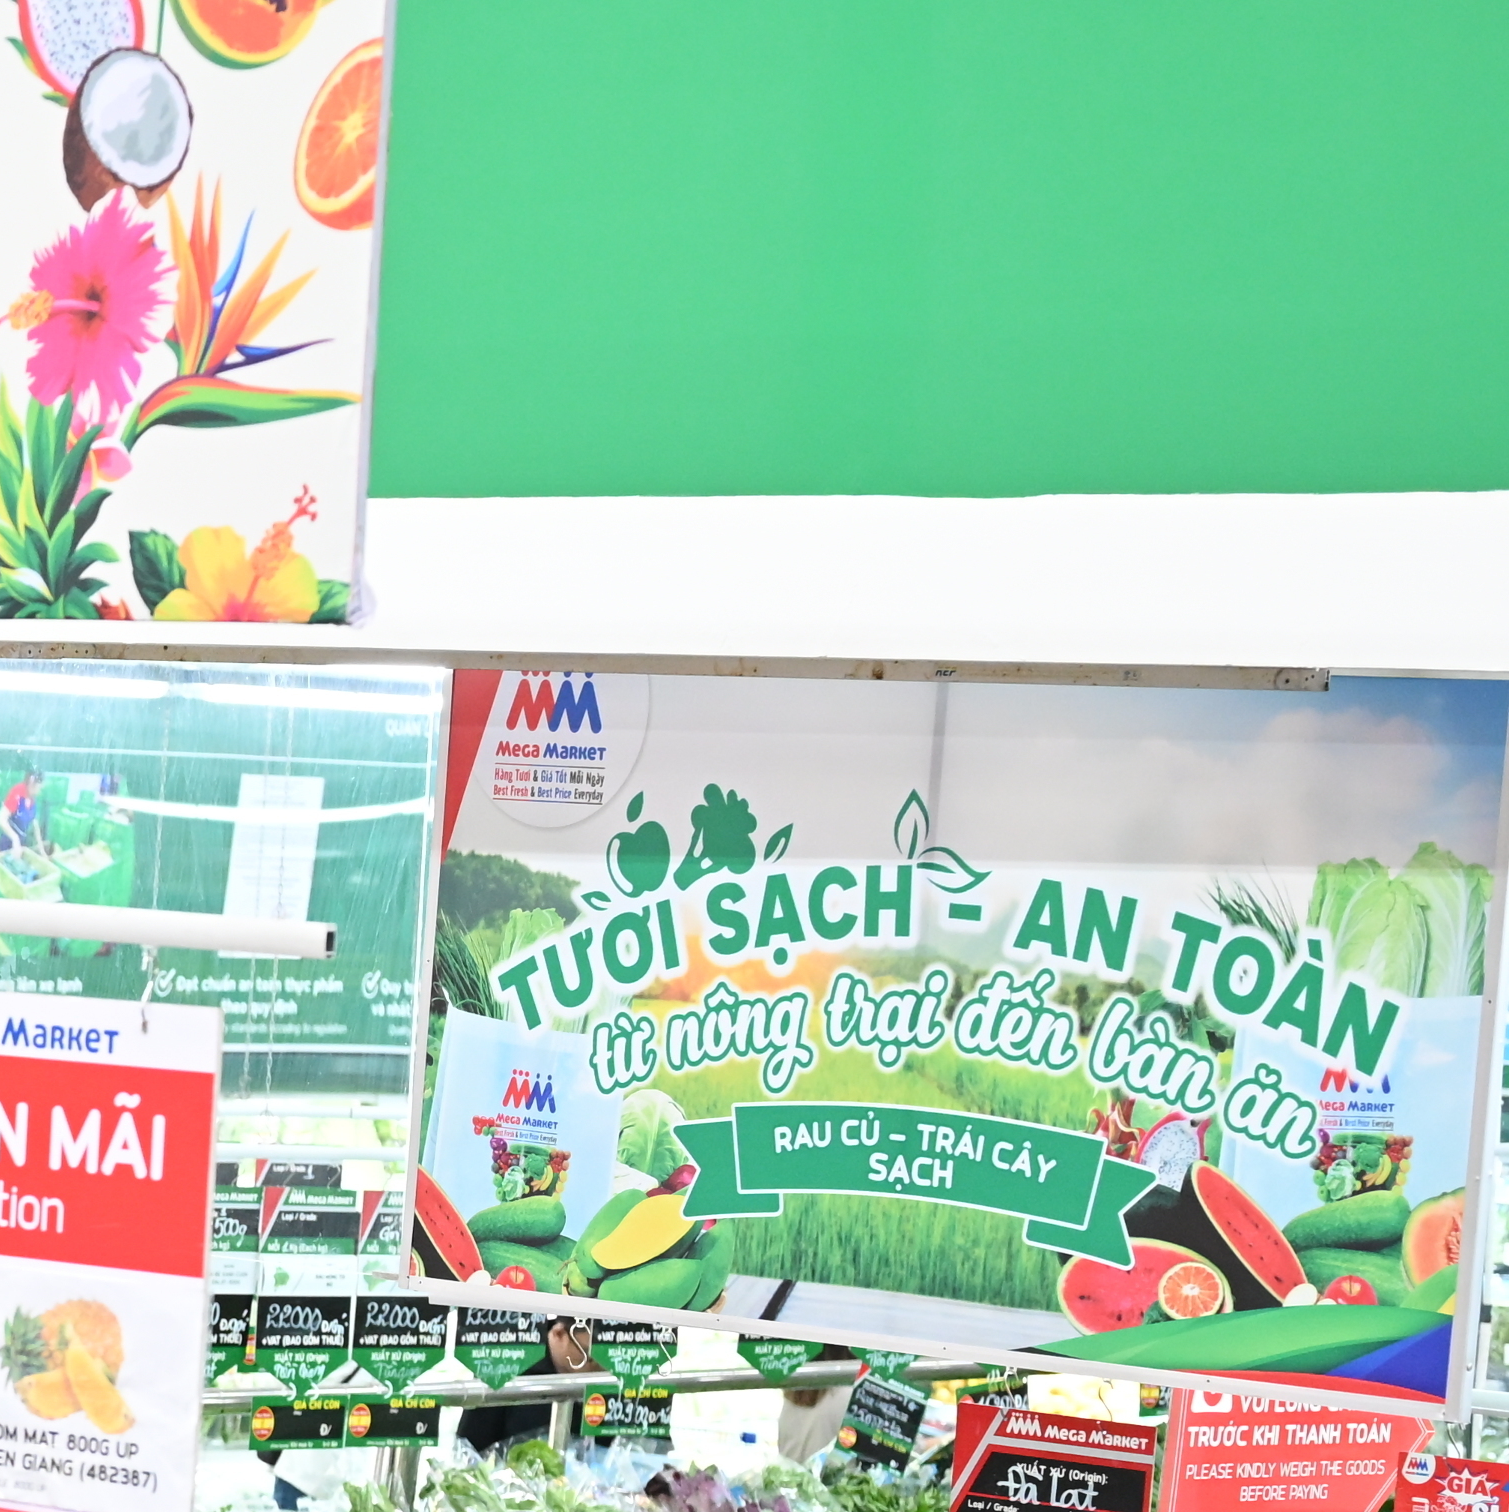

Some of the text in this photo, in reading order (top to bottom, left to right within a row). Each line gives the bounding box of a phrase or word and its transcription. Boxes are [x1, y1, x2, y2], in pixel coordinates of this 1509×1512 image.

[496, 741, 606, 760] Mega Market
[495, 768, 513, 783] Hàng
[541, 770, 552, 782] Giá
[555, 770, 567, 783] Tốt
[586, 772, 604, 787] Ngày
[493, 785, 603, 802] Best Fresh Best Price Everyday
[707, 865, 913, 965] SẠCH
[1013, 878, 1137, 972] AN
[1170, 911, 1400, 1078] TOÀN
[590, 968, 1317, 1159] từ nông trại đến bàn ăn
[49, 1091, 166, 1181] MÃI
[774, 1112, 1056, 1183] RAU CỦ TRÁI CÂY
[869, 1153, 954, 1191] SẠCH
[24, 1427, 58, 1448] MAT
[67, 1433, 109, 1456] 800G
[116, 1441, 139, 1458] UP
[1188, 1418, 1391, 1447] TRƯỚC KHI THANH TOÁN
[22, 1453, 73, 1478] GIANG
[80, 1462, 159, 1493] (482387)
[1186, 1460, 1385, 1479] PLEASE KINDLY WEIGH THE GOODS
[1240, 1484, 1328, 1501] BEFORE PAYING
